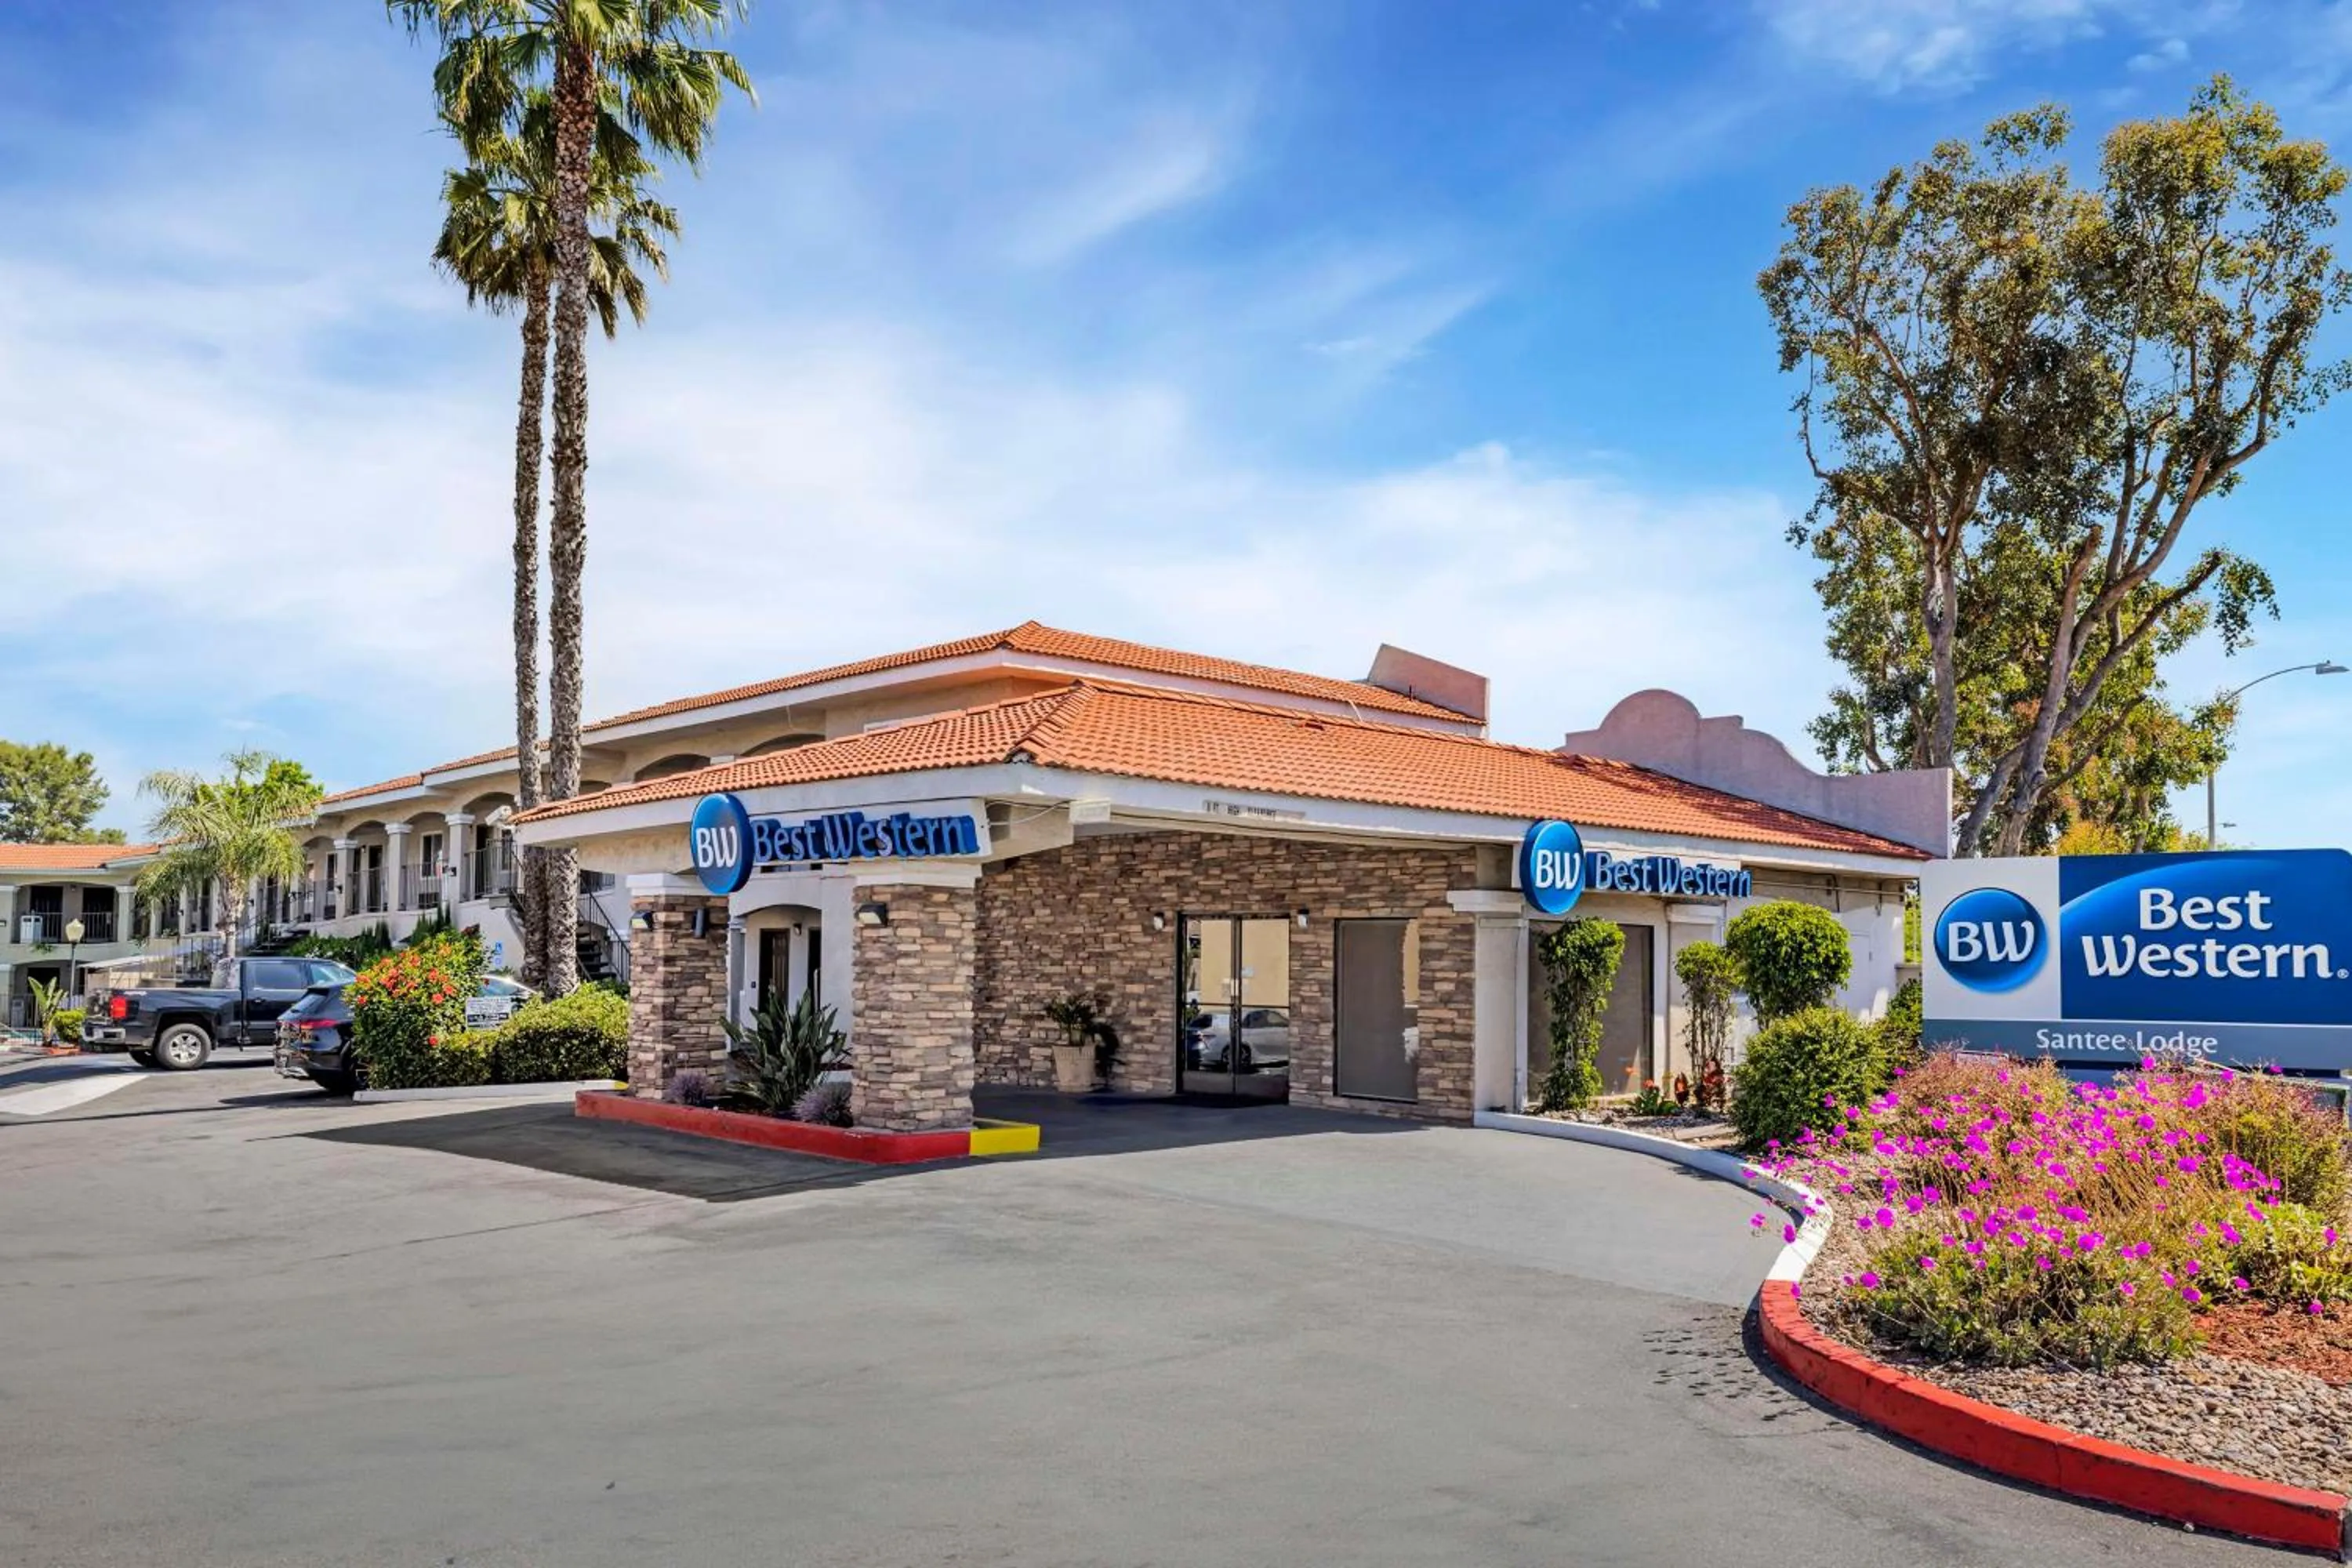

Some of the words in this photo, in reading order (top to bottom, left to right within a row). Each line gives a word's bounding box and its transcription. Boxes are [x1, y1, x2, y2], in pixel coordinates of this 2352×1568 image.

[696, 826, 738, 868] BW
[753, 818, 818, 862] Best
[822, 813, 968, 860] Western
[1535, 849, 1580, 890] BW
[1595, 851, 1652, 891] Best
[1657, 858, 1751, 898] Western
[2140, 888, 2273, 931] Best
[1947, 920, 2034, 963] BW
[2036, 1029, 2126, 1051] Santee
[2136, 1031, 2219, 1058] Lodge
